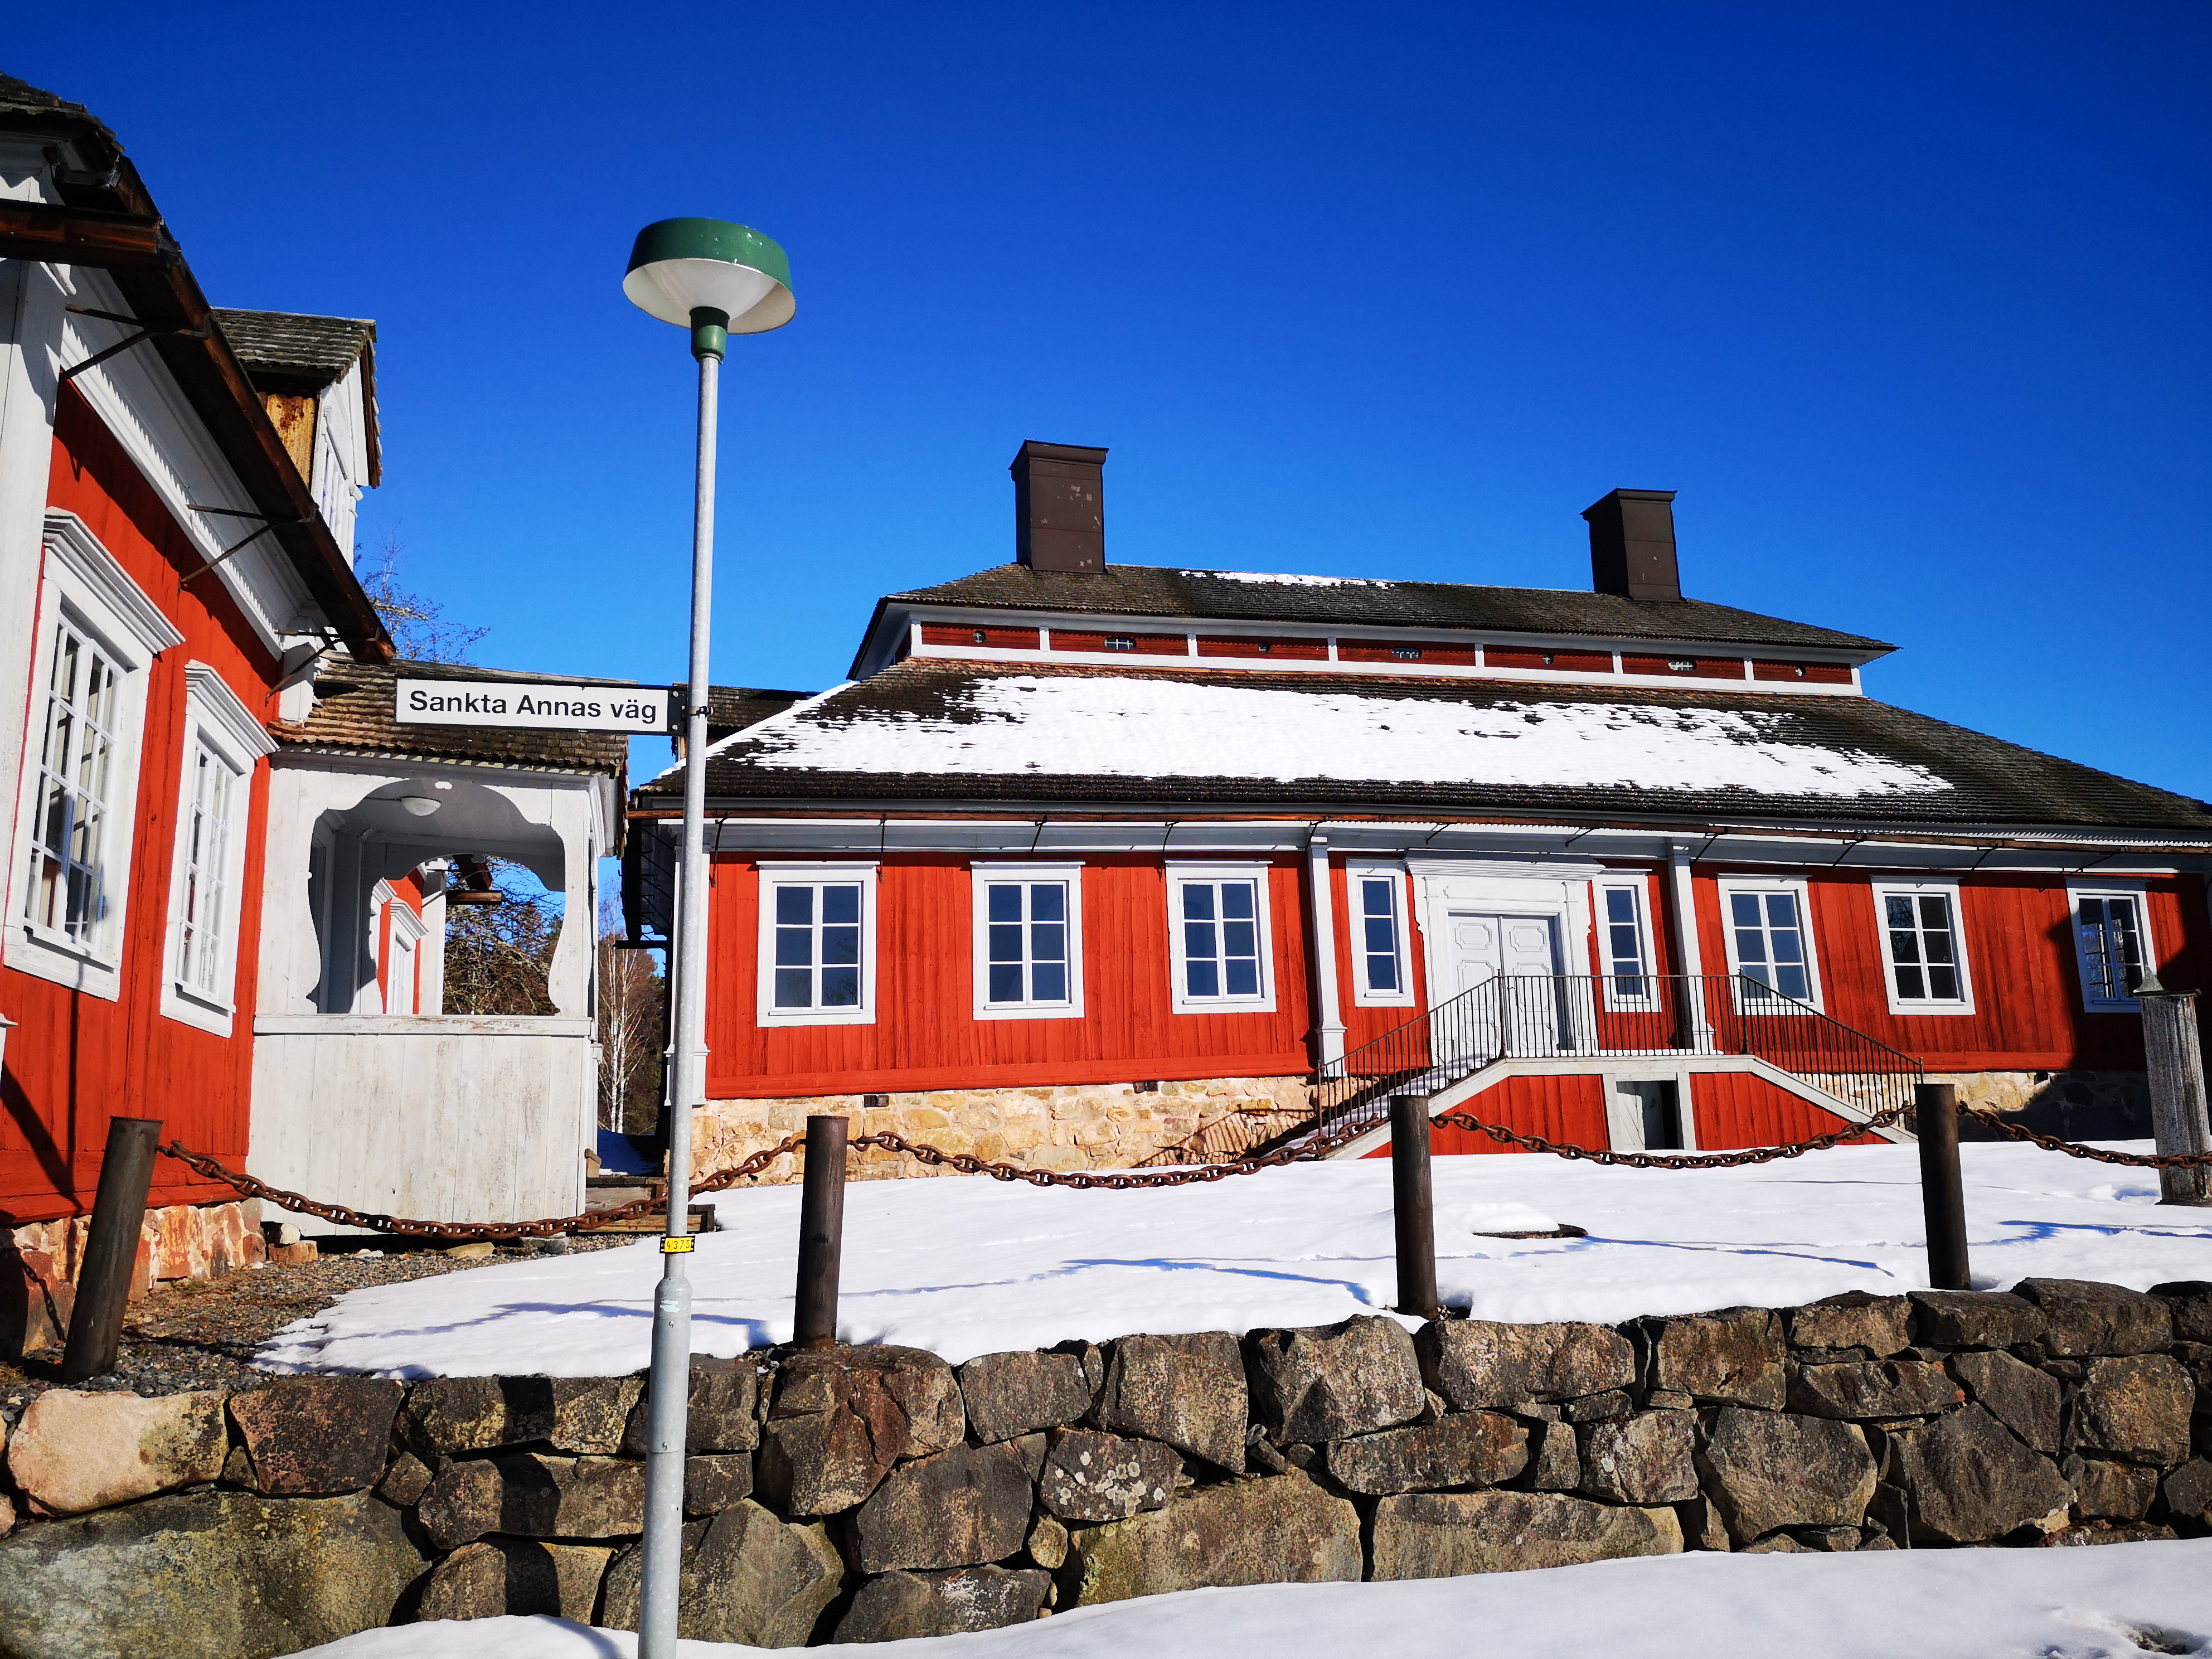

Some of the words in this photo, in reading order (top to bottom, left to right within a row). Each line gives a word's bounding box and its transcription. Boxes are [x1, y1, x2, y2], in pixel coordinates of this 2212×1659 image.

[409, 690, 507, 714] Sankta
[516, 695, 601, 717] Annas
[610, 699, 657, 724] väg
[666, 1240, 690, 1250] 4375
